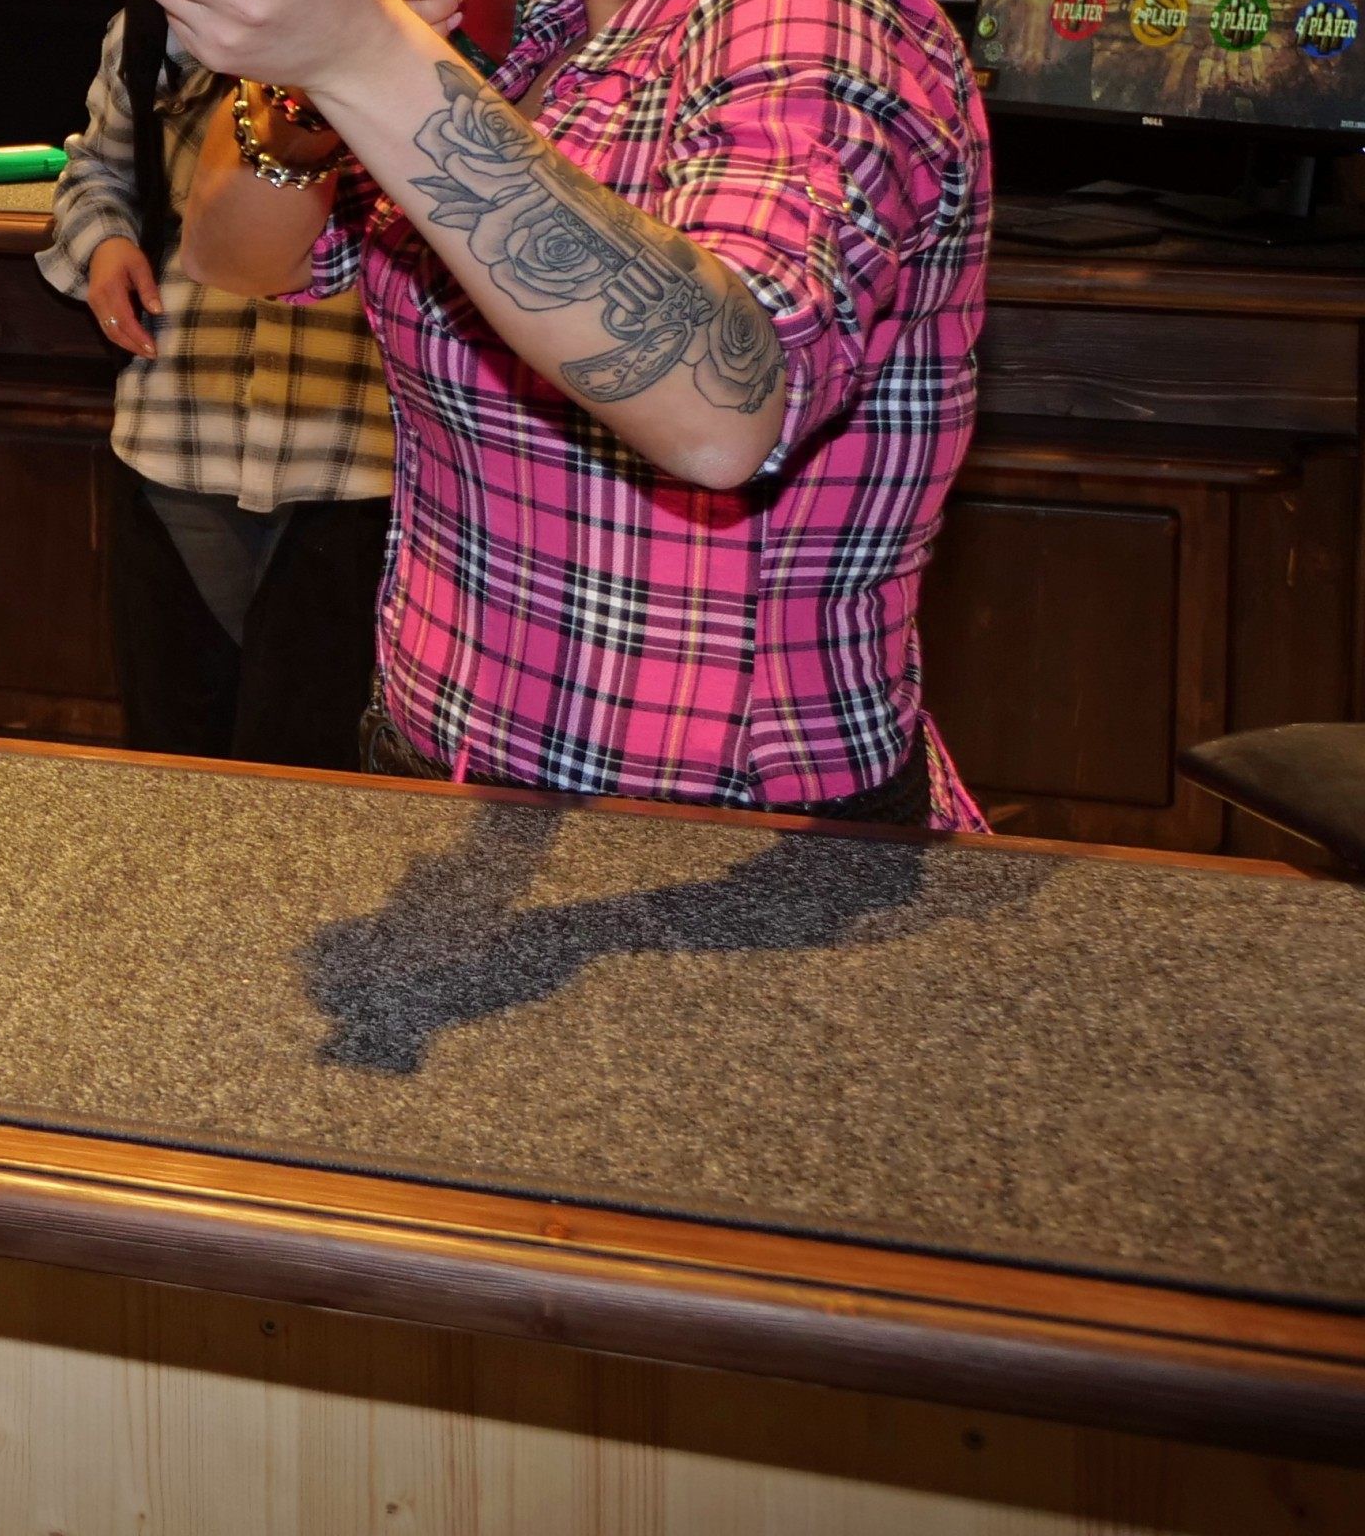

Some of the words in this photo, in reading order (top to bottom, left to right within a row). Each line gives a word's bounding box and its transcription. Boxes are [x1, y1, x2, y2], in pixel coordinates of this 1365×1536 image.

[1053, 4, 1060, 20] 1
[1061, 4, 1103, 22] PLAYER
[1134, 7, 1142, 24] 2
[1145, 8, 1188, 27] PLAYER
[1210, 11, 1218, 28] 3
[1222, 11, 1267, 31] PLAYER
[1295, 17, 1304, 35] 4
[1308, 16, 1357, 38] PLAYER
